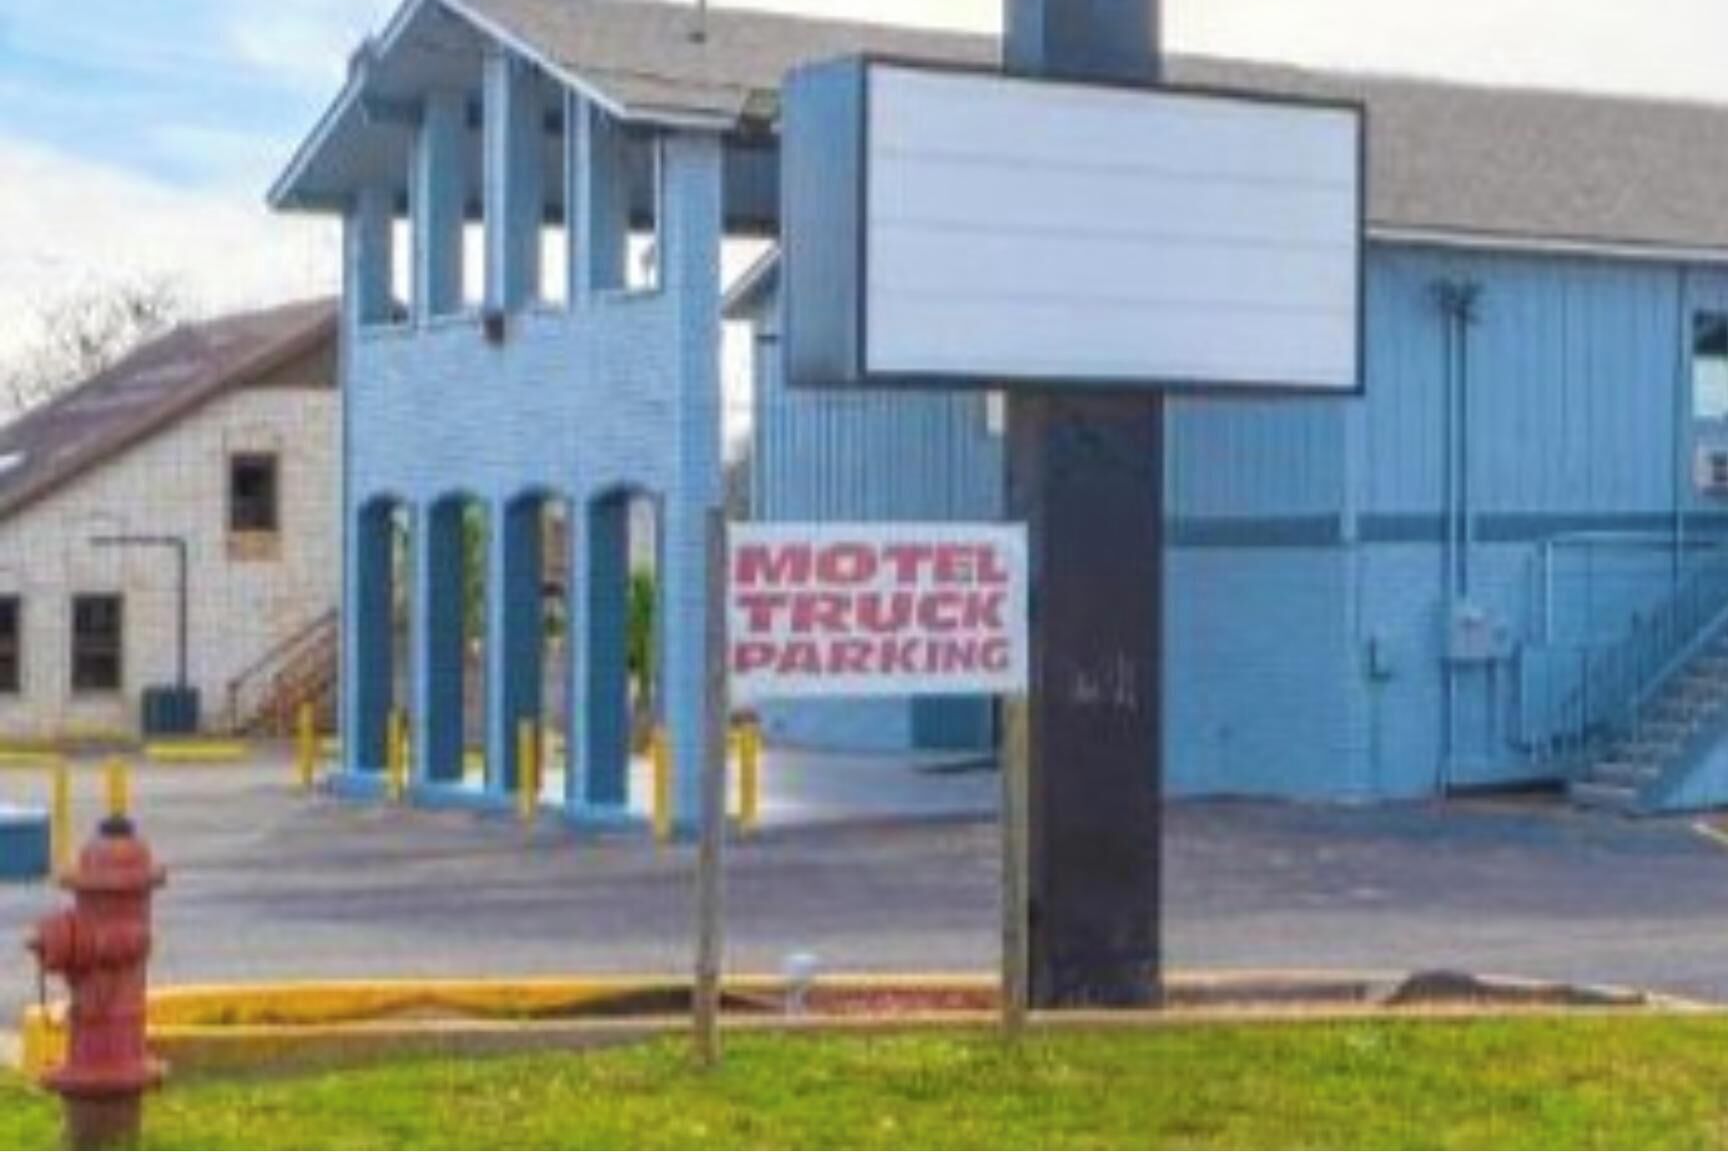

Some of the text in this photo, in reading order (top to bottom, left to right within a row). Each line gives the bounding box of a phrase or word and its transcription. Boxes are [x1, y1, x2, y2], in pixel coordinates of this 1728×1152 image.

[734, 541, 1008, 585] MOTEL
[736, 591, 1004, 634] TRUCK
[734, 636, 1010, 676] PARKING
